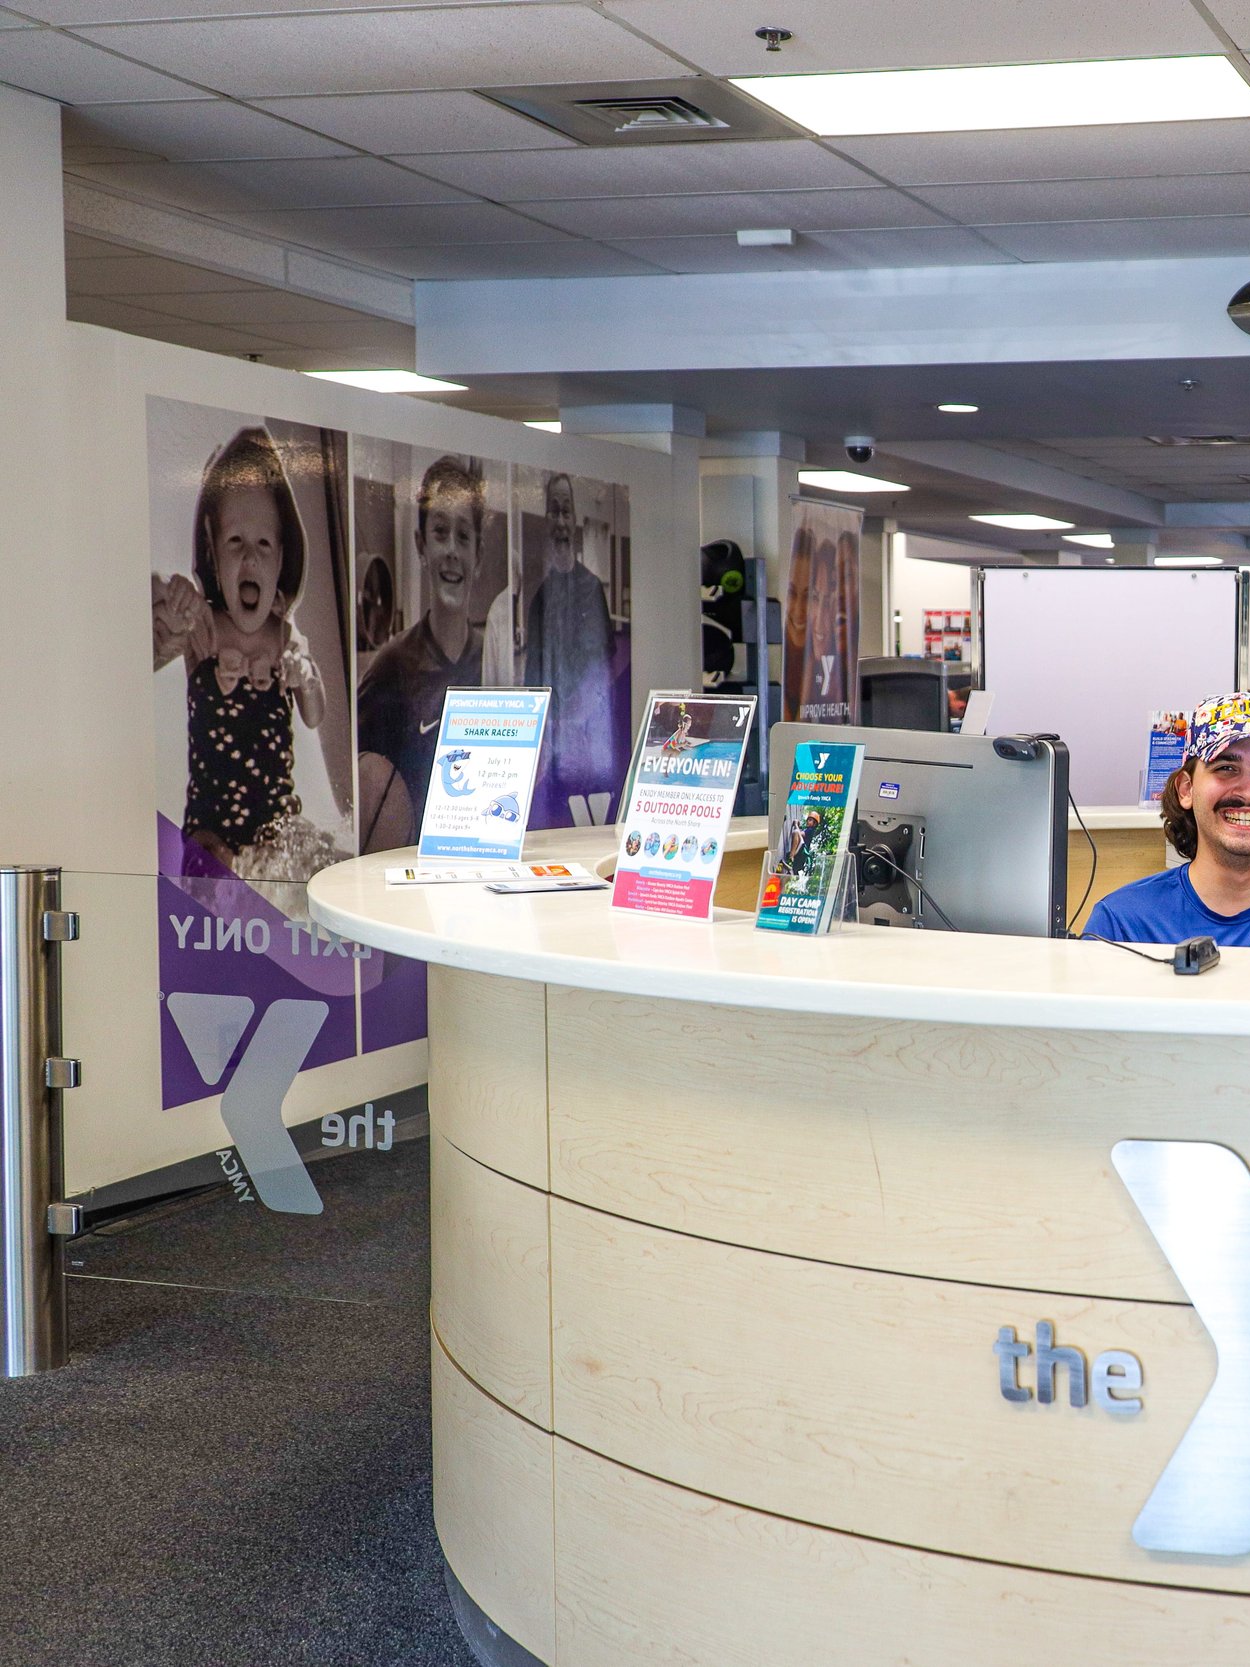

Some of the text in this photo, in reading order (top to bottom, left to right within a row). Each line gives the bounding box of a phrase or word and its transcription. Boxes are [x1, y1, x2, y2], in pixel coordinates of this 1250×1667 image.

[821, 655, 834, 696] Y
[449, 698, 524, 709] IPSWICH FAMILY YMCA
[800, 704, 826, 718] IMPROVE
[736, 707, 750, 727] Y
[449, 718, 538, 728] INDOOR POOL BLOW UP
[464, 728, 518, 737] SHARK RACES!
[487, 757, 512, 767] July 11
[643, 755, 733, 777] EVERYONE IN!
[817, 753, 830, 769] Y
[478, 769, 486, 777] 12
[796, 772, 843, 782] CHOOSE YOUR
[791, 782, 844, 793] ADVENTURE!
[640, 788, 657, 797] ENJOY
[658, 790, 680, 799] MEMBER
[681, 791, 695, 800] ONLY
[695, 793, 717, 802] ACCESS
[636, 801, 722, 819] 5 OUTDOOR POOLS
[437, 845, 508, 855] www.northshoreymca.org
[780, 896, 821, 908] DAY CAMP
[778, 907, 817, 916] REGISTRATION
[994, 1321, 1143, 1414] the
